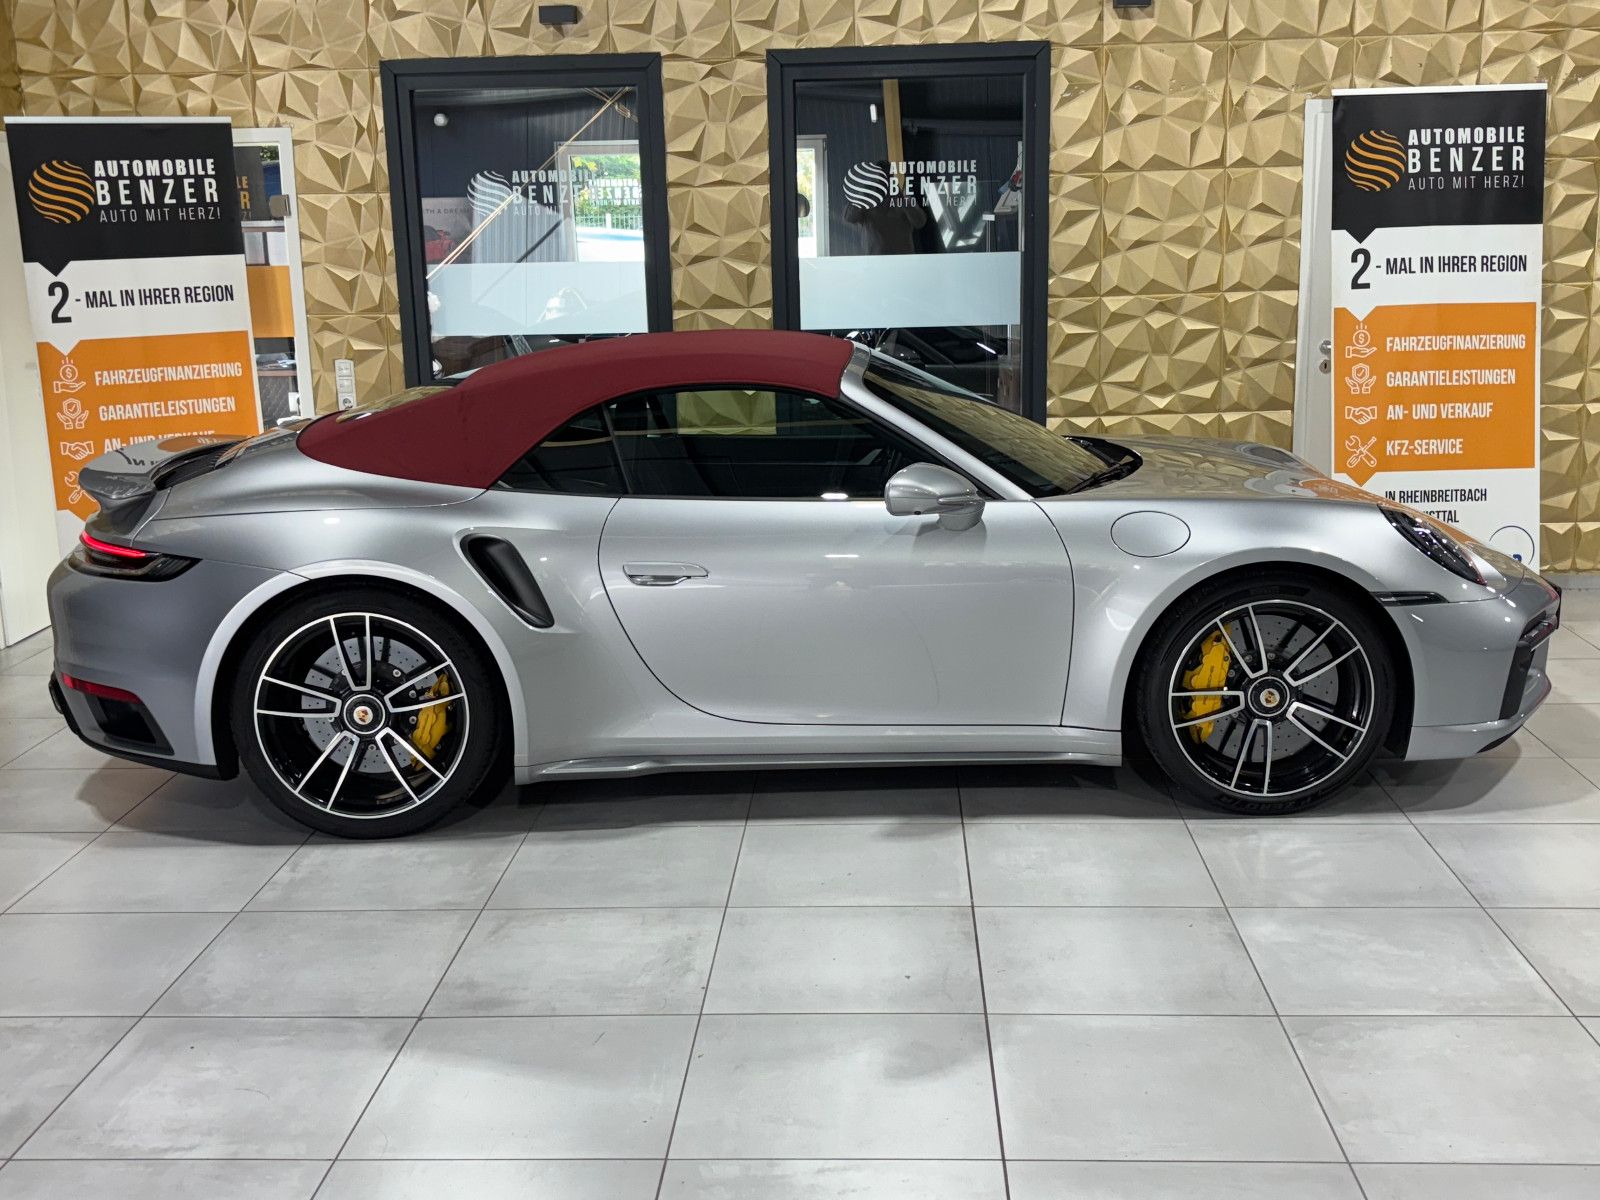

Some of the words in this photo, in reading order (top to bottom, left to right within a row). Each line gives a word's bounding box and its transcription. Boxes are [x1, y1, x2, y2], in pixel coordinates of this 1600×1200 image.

[1408, 126, 1525, 146] AUTOMOBILE
[94, 158, 216, 177] AUTOMOBILE
[889, 160, 977, 175] AUTOMOBILE
[1408, 146, 1525, 174] BENZER
[96, 177, 219, 206] BENZER
[889, 175, 977, 196] BENZER
[1408, 176, 1444, 191] AUTO
[1452, 175, 1476, 189] MIT
[1484, 174, 1525, 189] HERZ!
[889, 197, 917, 208] AUTO
[100, 208, 138, 223] AUTO
[145, 207, 170, 222] MIT
[179, 206, 221, 220] HERZ!
[1351, 248, 1371, 290] 2
[1385, 257, 1416, 275] MAL
[1420, 256, 1434, 274] IN
[1438, 255, 1477, 273] IHRER
[1481, 254, 1527, 272] REGION
[48, 281, 72, 324] 2
[85, 290, 117, 309] MAL
[120, 289, 135, 307] IN
[138, 287, 181, 306] IHRER
[184, 284, 235, 304] REGION
[1386, 333, 1526, 353] FAHRZEUGFINANZIERUNG
[95, 362, 242, 386] FAHRZEUGFINANZIERUNG
[1386, 369, 1516, 388] GARANTIELEISTUNGEN
[99, 396, 236, 422] GARANTIELEISTUNGEN
[1387, 404, 1409, 420] AN-
[1412, 403, 1437, 420] UND
[1440, 402, 1494, 419] VERKAUF
[103, 438, 127, 454] AN-
[1386, 438, 1463, 456] KFZ-SERVICE
[1385, 490, 1396, 501] IN
[1399, 488, 1487, 503] RHEINBREITBACH
